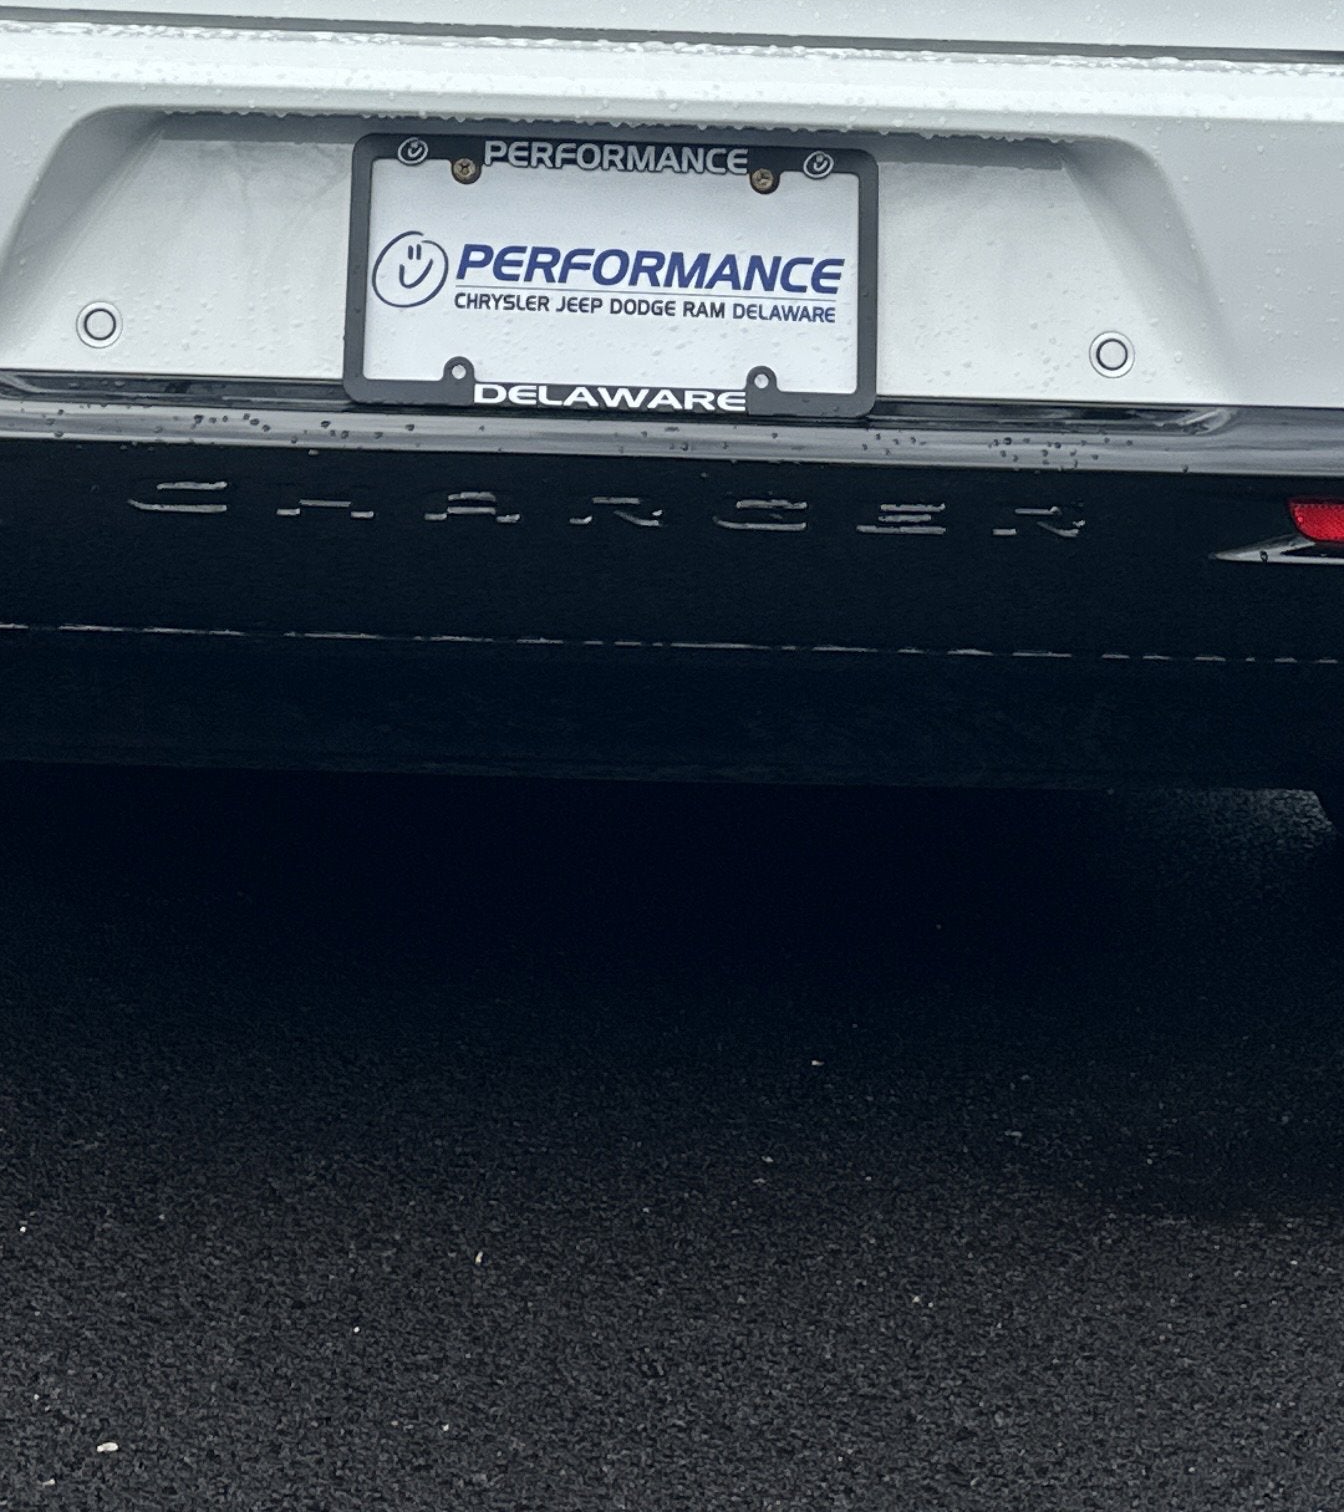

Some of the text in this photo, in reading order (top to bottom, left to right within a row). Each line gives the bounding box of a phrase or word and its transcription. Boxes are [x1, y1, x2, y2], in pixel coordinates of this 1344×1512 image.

[483, 139, 750, 175] PERFORMANCE
[456, 243, 847, 296] PERFORMANCE
[454, 291, 837, 324] CHRYSLER JEEP DODGE RAM DELAWARE
[472, 382, 747, 413] DELAWARE
